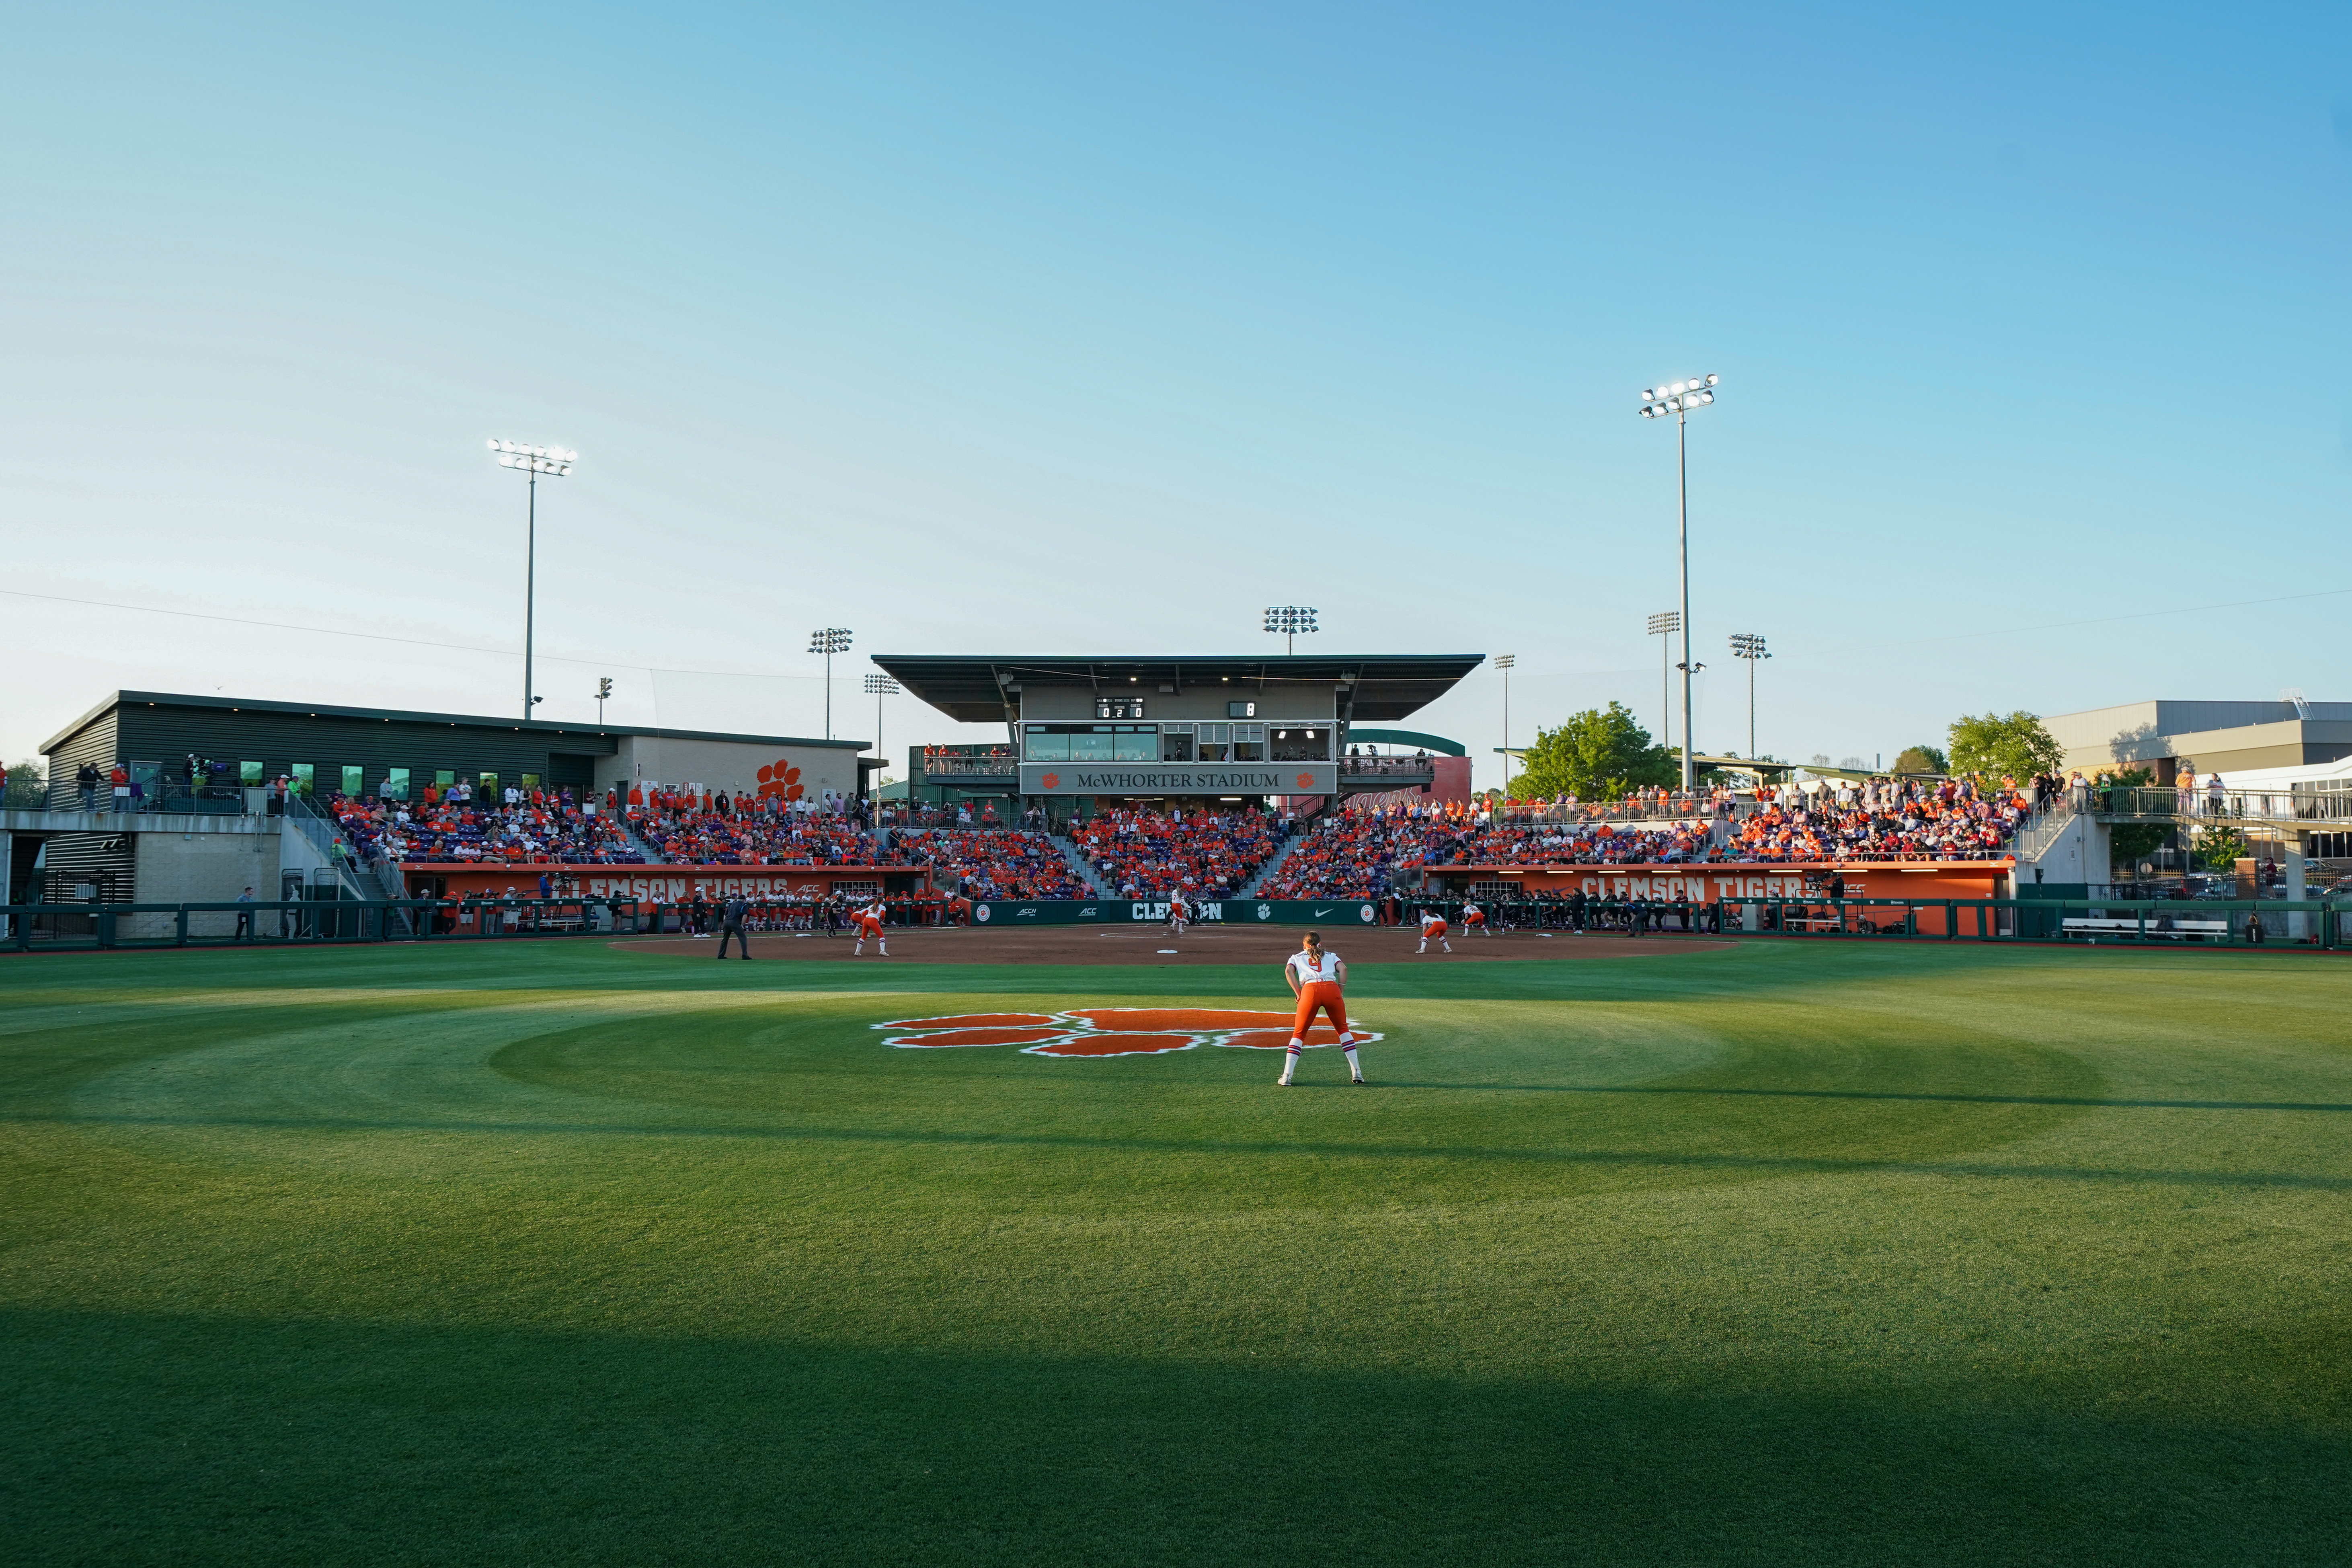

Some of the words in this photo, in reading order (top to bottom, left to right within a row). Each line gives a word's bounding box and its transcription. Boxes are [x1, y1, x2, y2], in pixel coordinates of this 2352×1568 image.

[1103, 708, 1109, 717] 0
[1117, 709, 1122, 717] 2
[1135, 708, 1141, 717] 0
[1247, 703, 1254, 716] 8
[1077, 774, 1192, 787] McWHORTER
[1197, 774, 1279, 787] STADIUM
[1582, 877, 1705, 902] CLEMSON
[1308, 958, 1322, 973] 9
